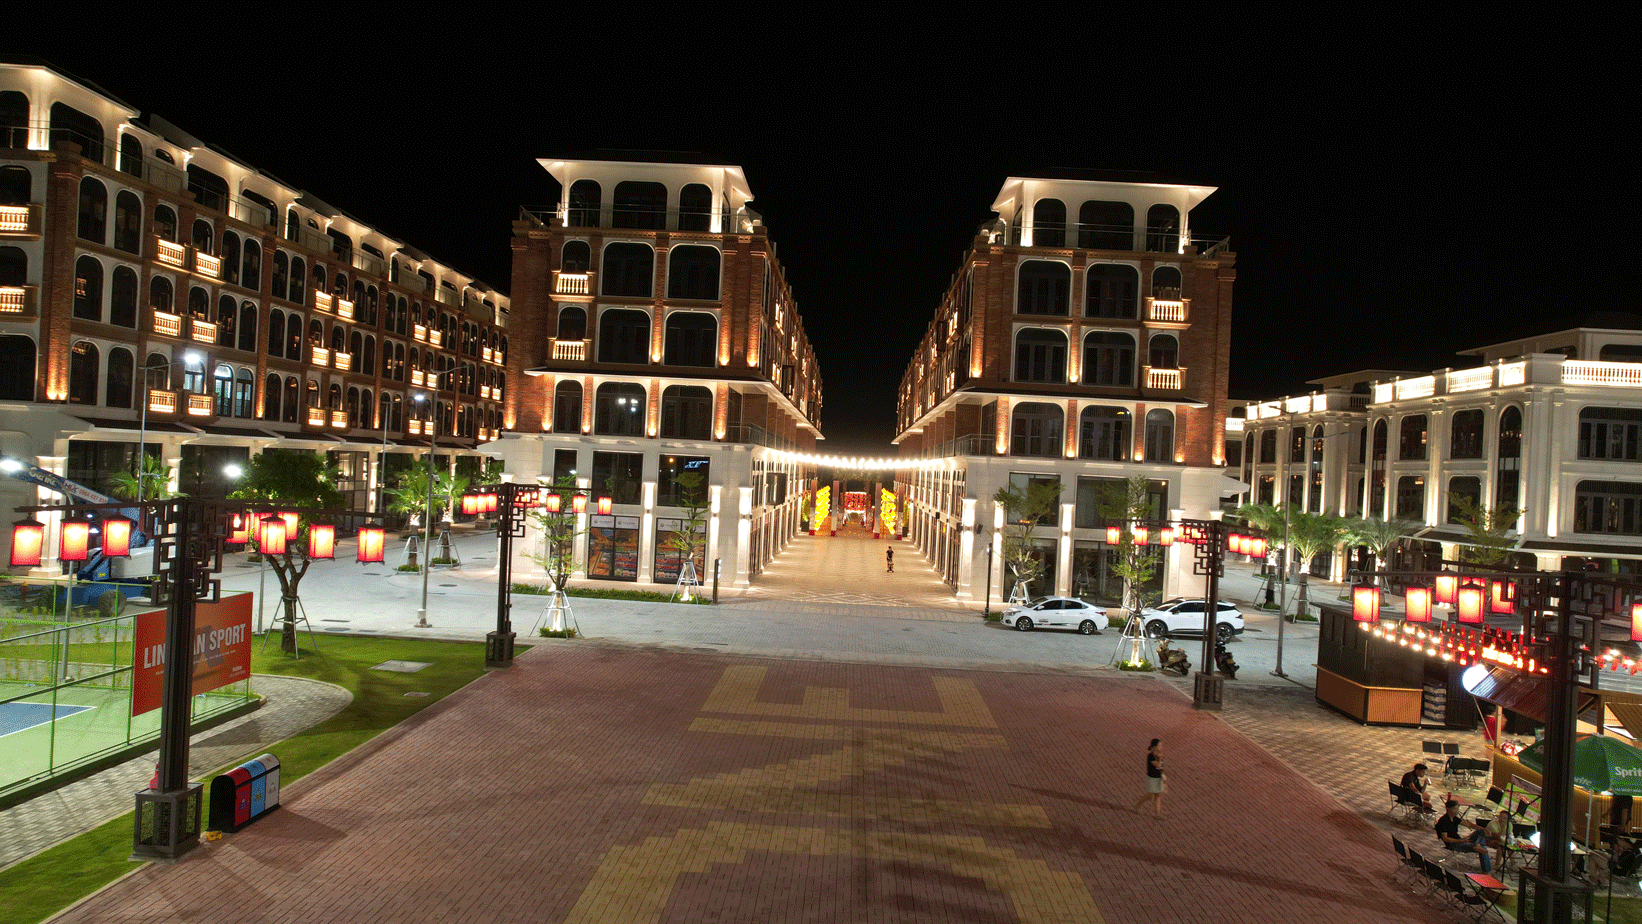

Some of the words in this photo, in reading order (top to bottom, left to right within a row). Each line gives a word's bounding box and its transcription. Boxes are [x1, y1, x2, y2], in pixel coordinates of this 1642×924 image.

[144, 643, 166, 669] LIN
[209, 623, 246, 651] SPORT
[1615, 766, 1642, 778] Sprit
